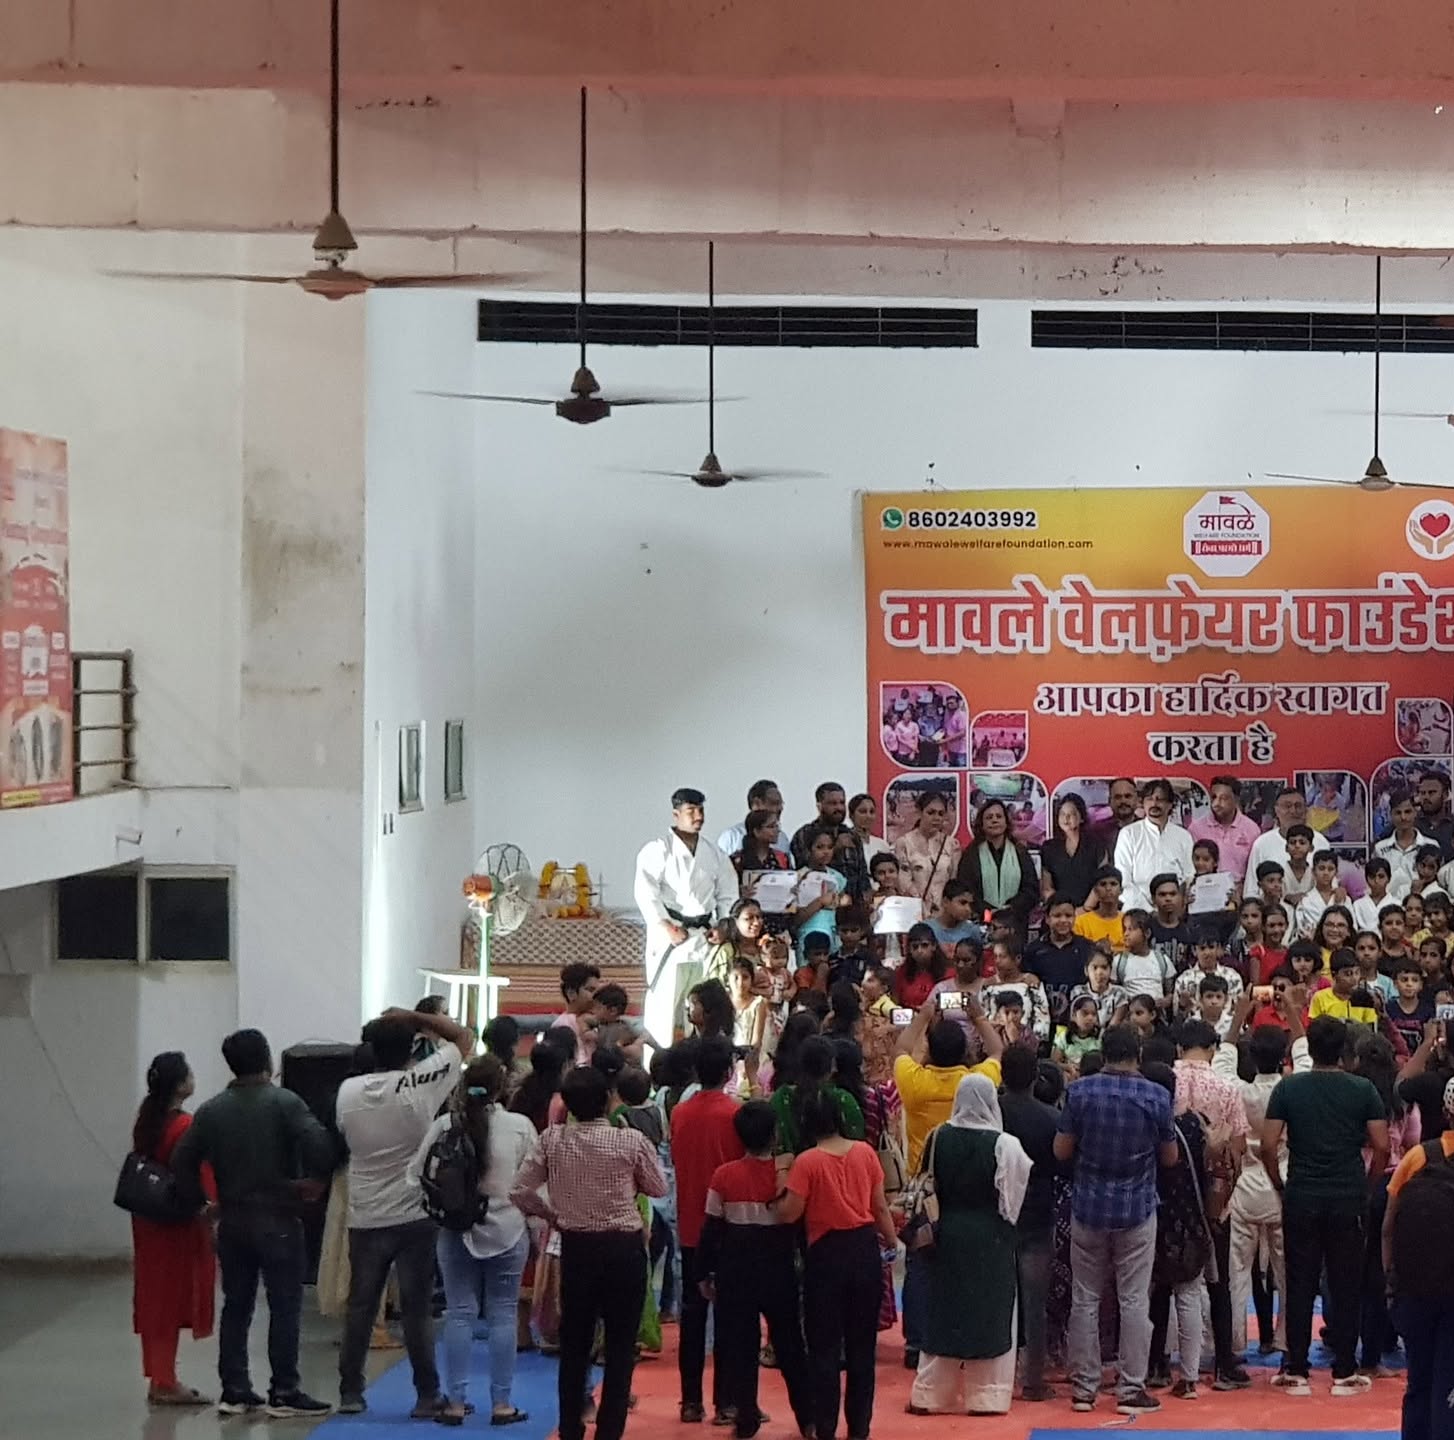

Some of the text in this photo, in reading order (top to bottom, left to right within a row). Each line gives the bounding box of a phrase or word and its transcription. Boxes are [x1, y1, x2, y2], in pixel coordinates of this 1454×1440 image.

[908, 511, 1036, 528] 8602403992
[883, 538, 1093, 550] www.mawalewelfarefoundation.com
[886, 580, 1049, 647] मावले
[1036, 673, 1388, 714] आपका हार्दिक स्वागत
[1147, 723, 1273, 761] करता है
